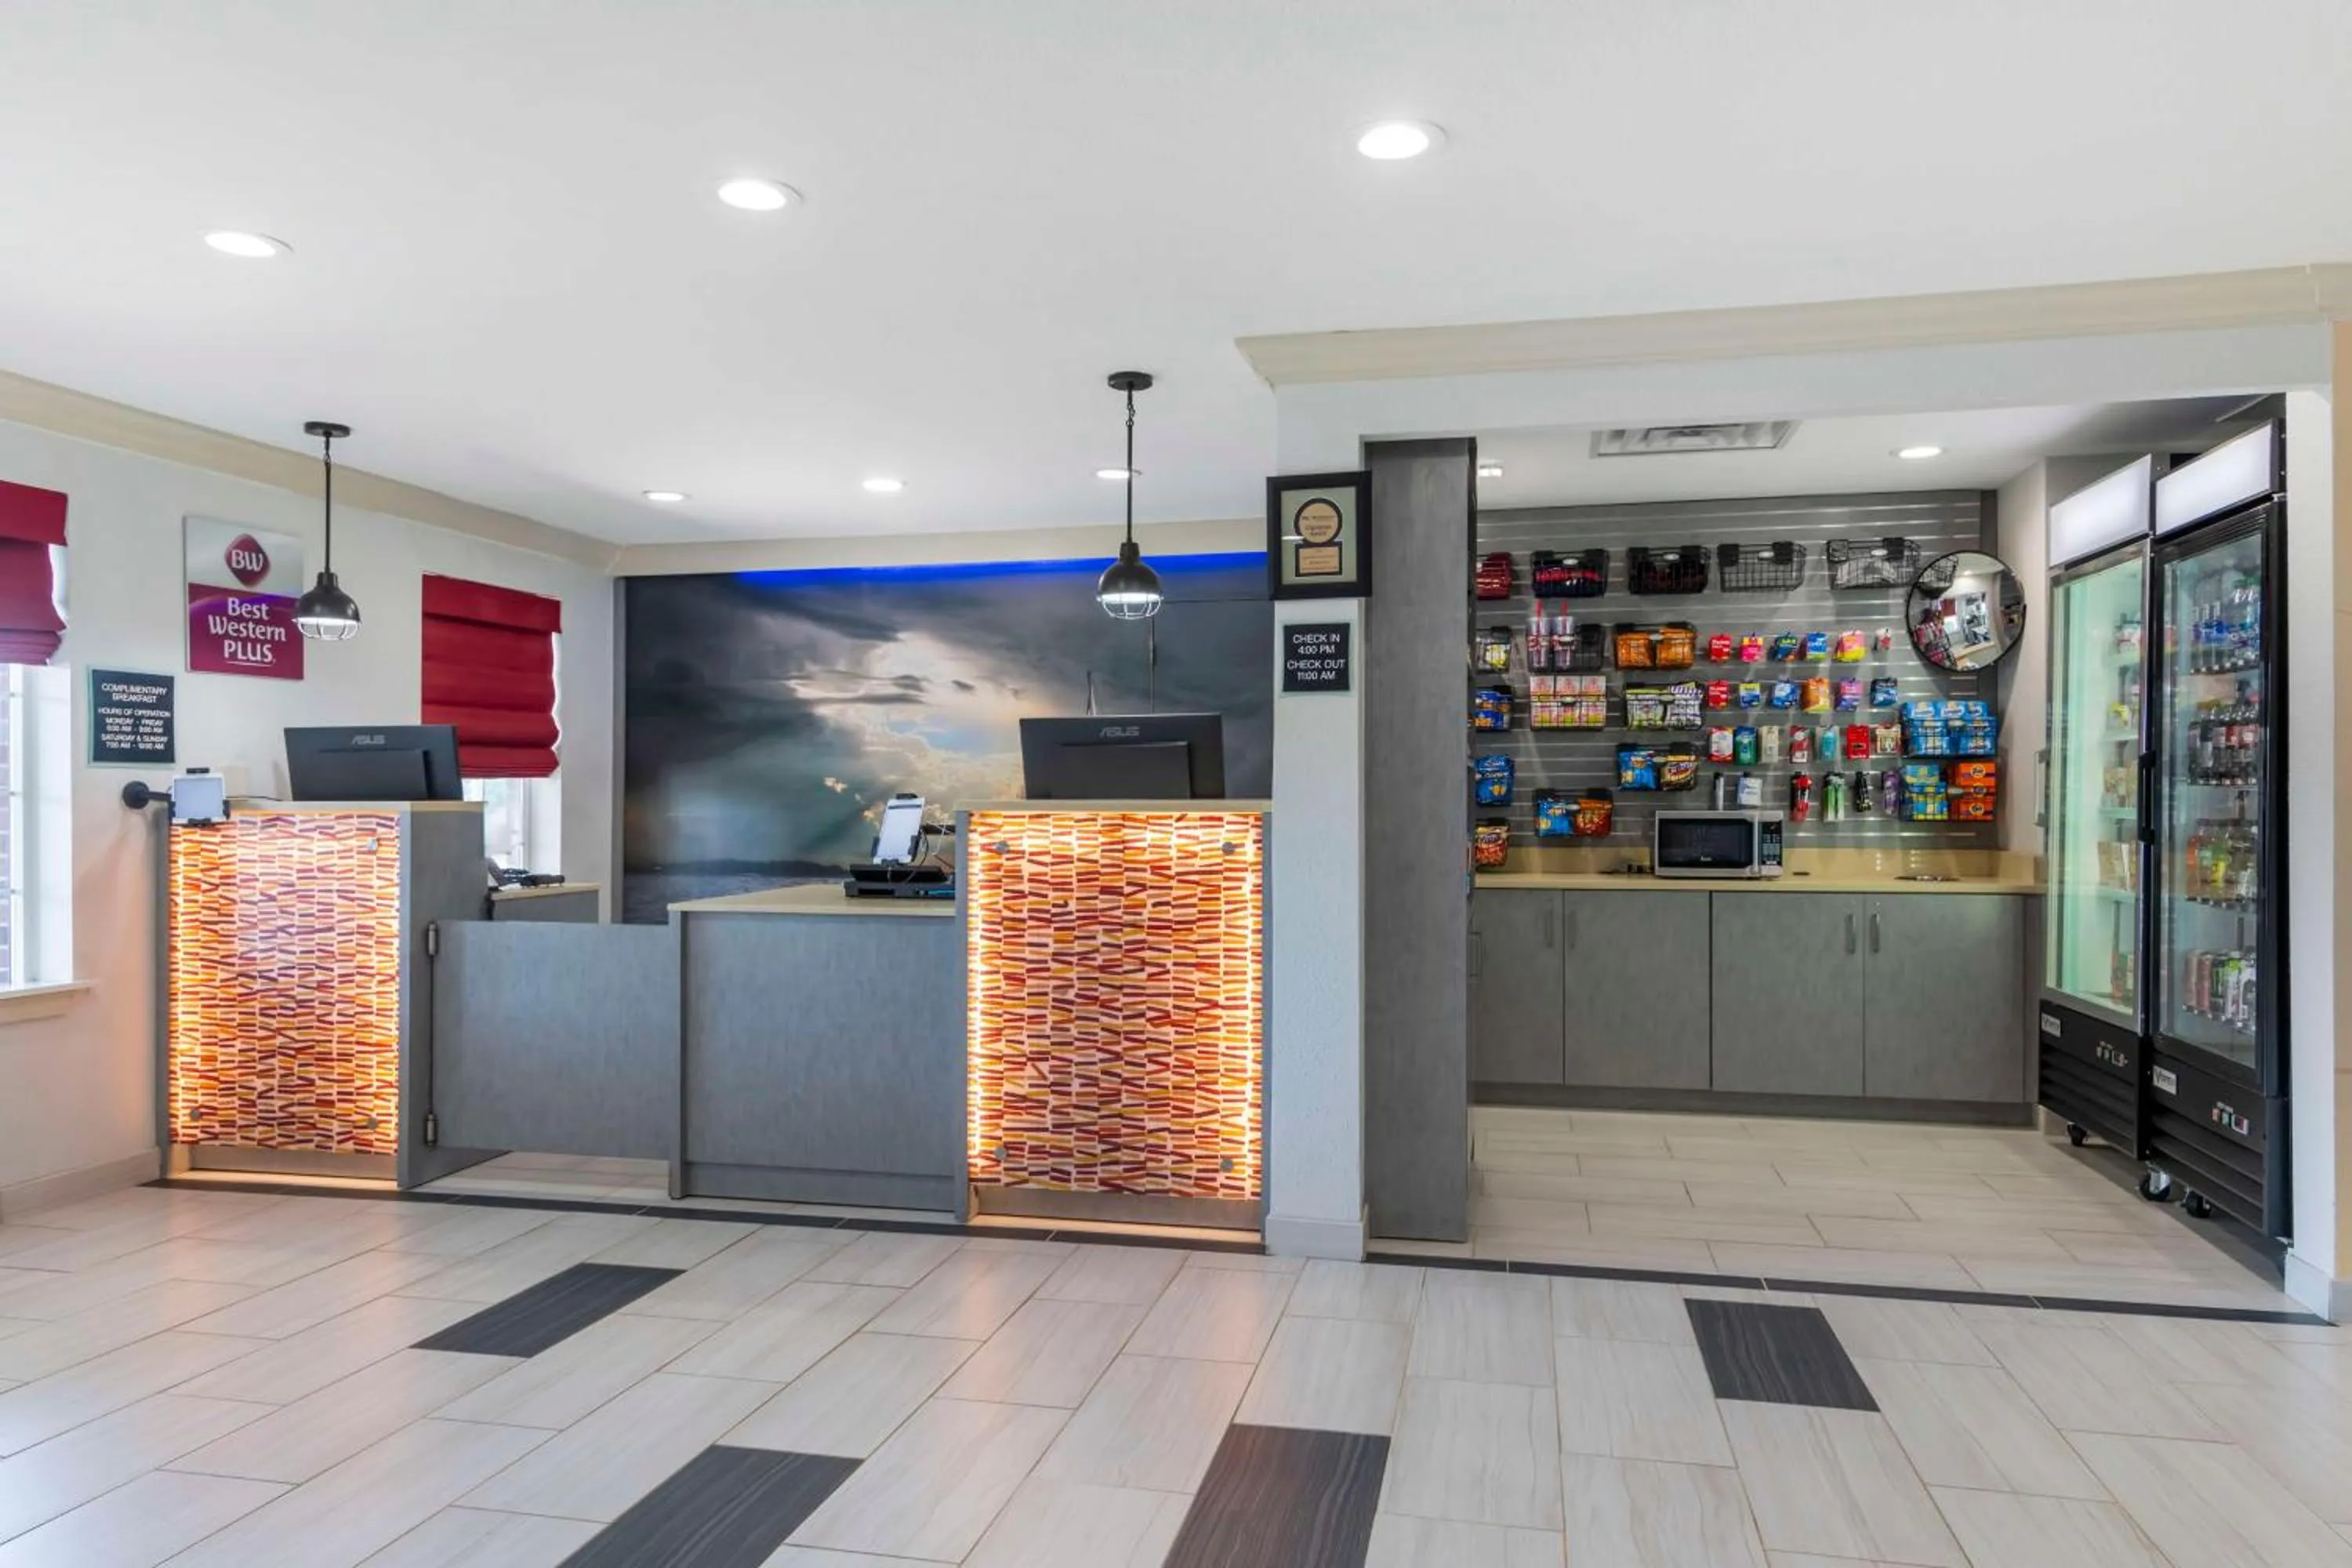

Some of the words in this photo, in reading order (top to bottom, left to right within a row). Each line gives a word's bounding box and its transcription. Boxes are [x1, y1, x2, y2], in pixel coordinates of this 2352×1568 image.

[231, 550, 264, 572] BW
[228, 597, 269, 621] Best
[208, 615, 287, 642] Western
[1293, 633, 1328, 644] CHECK
[1330, 633, 1341, 643] IN
[223, 640, 274, 663] PLUS
[1298, 645, 1318, 655] 4:00
[1319, 644, 1335, 654] PM
[1287, 659, 1323, 670] CHECK
[1324, 659, 1345, 669] OUT
[1297, 671, 1318, 681] 11:00
[1319, 671, 1336, 680] AM
[101, 683, 168, 696] COMPLIMENTARY
[112, 692, 157, 703] BREAKFAST
[1100, 727, 1139, 737] ASUS
[101, 734, 135, 742] SATURDAY
[350, 735, 385, 746] ASUS
